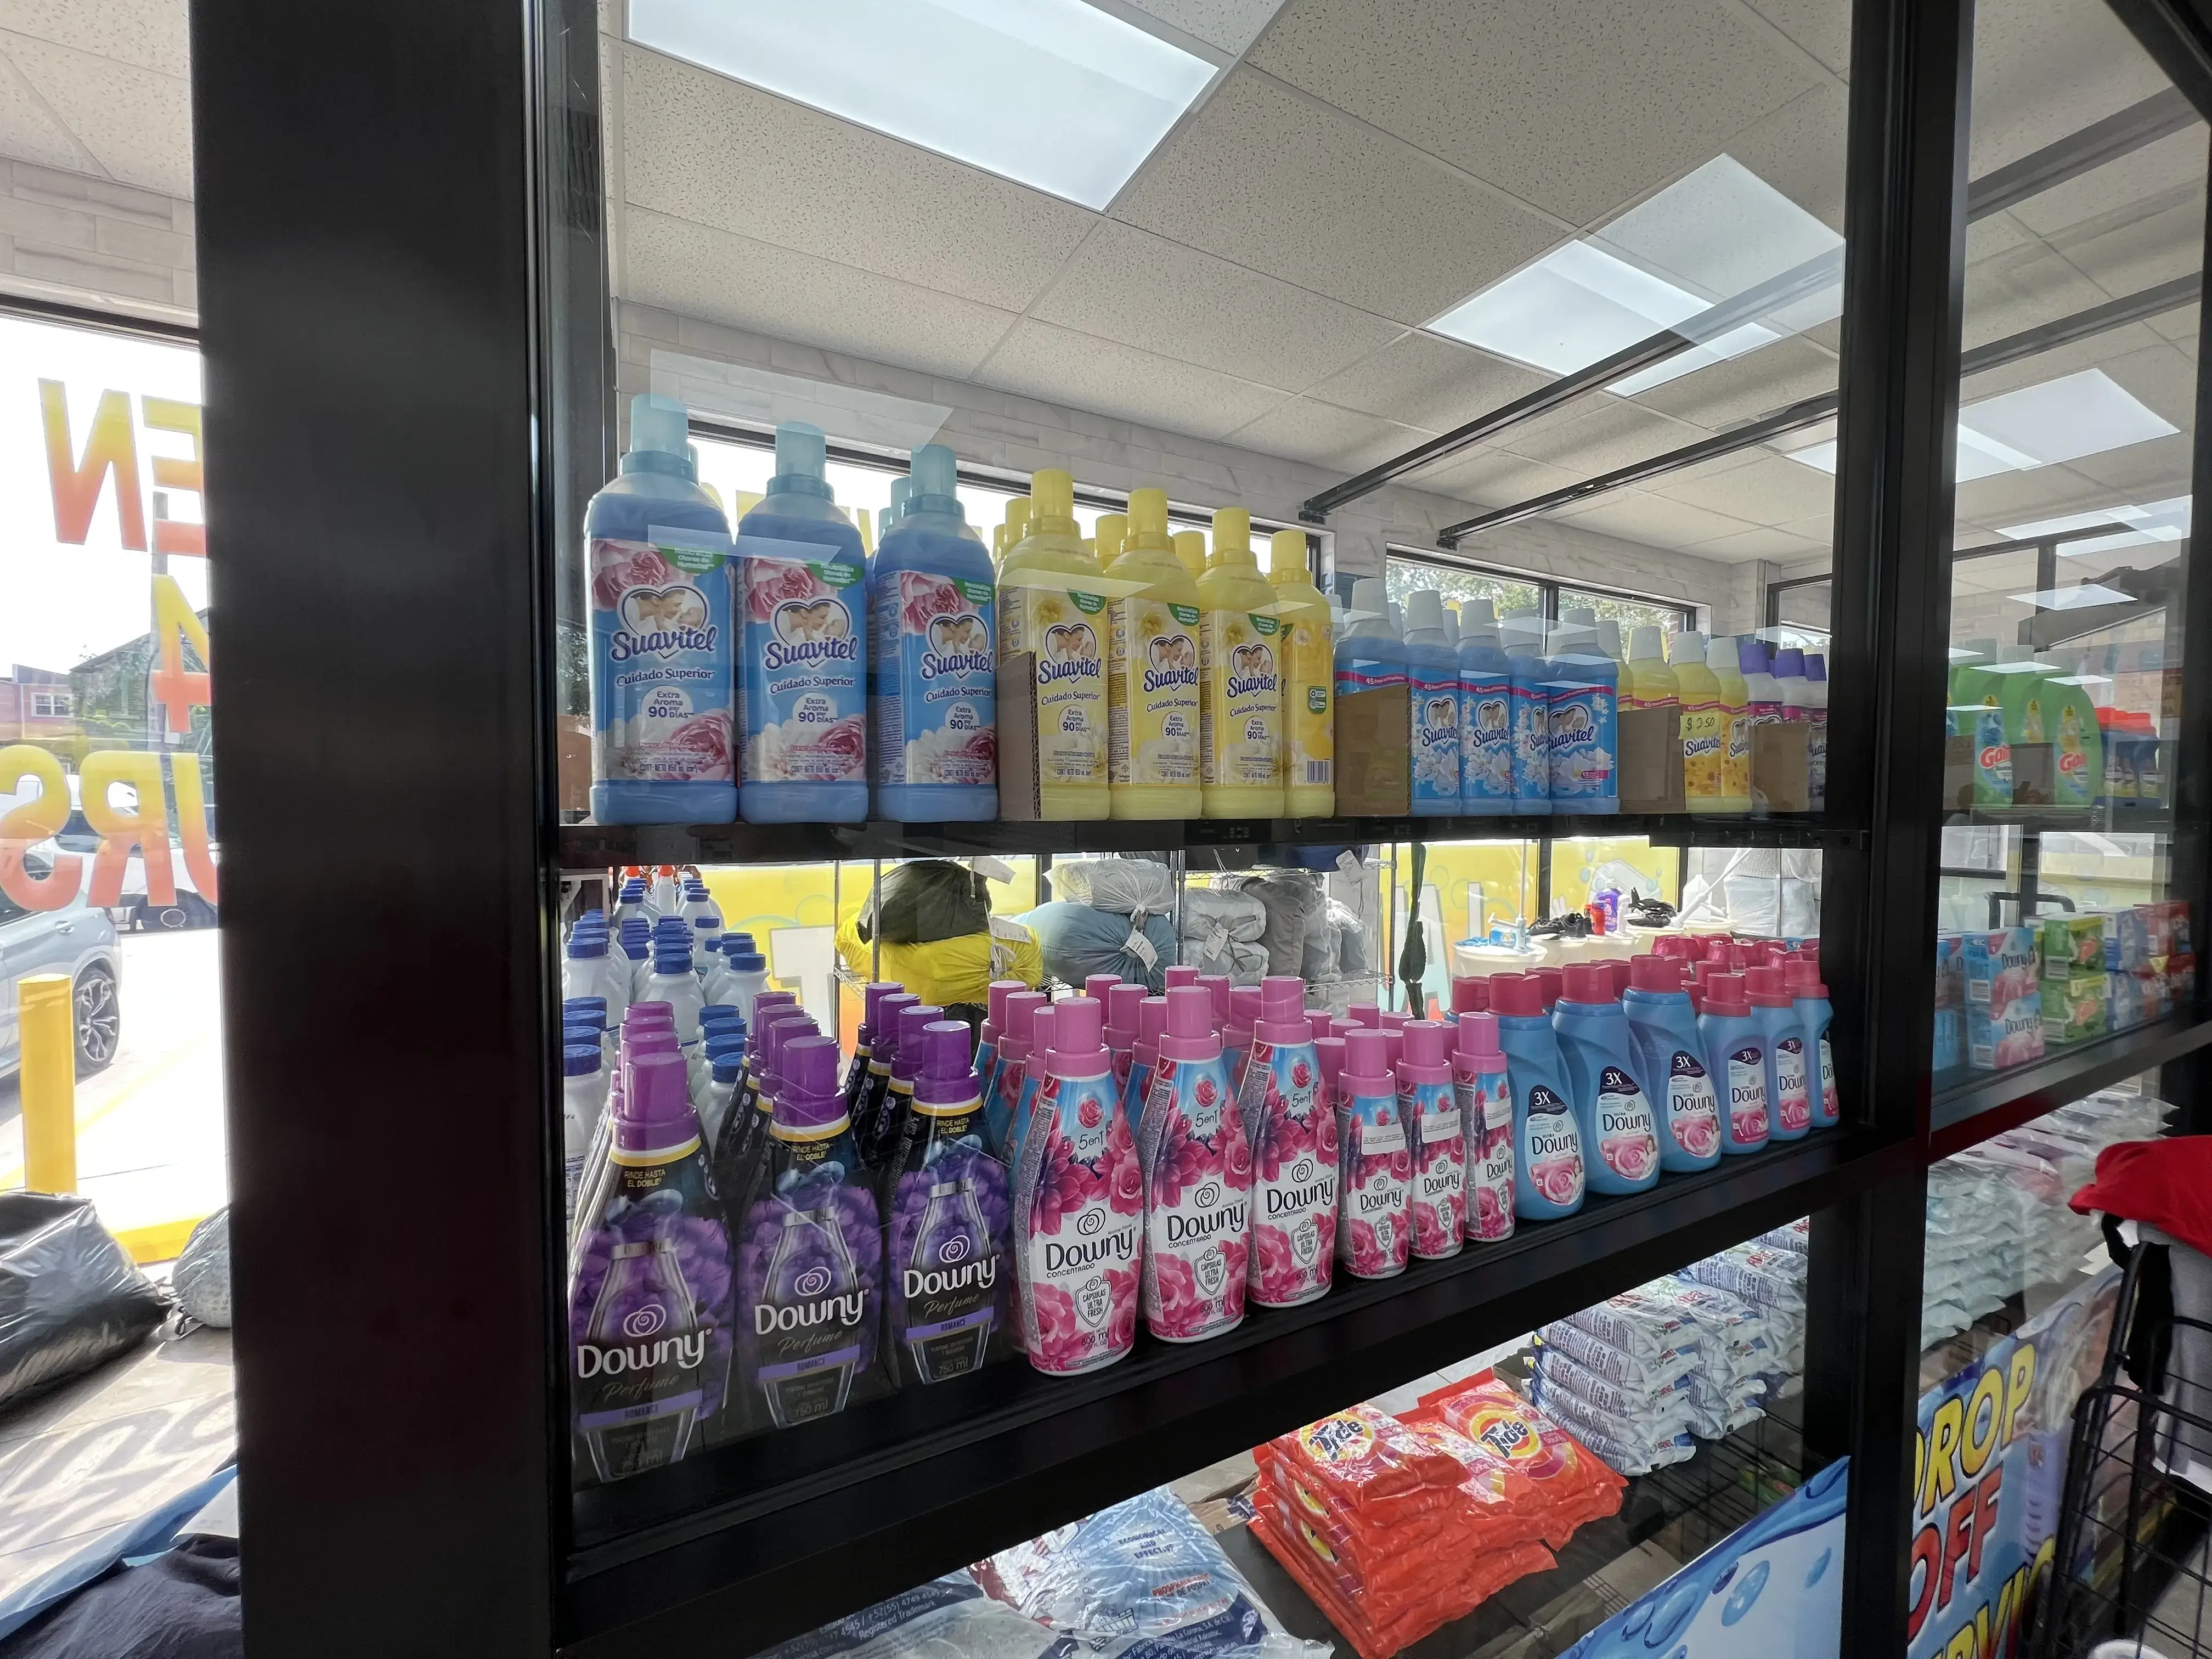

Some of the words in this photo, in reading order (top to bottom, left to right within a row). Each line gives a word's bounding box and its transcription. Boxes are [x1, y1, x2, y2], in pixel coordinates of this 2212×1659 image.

[611, 626, 718, 661] Suavitel
[766, 637, 857, 669] Suavitel
[922, 650, 993, 679] Suavitel
[1038, 658, 1102, 684] Suavitel
[617, 670, 663, 687] Cuidado
[665, 668, 713, 679] Superior
[770, 678, 811, 693] Cuidado
[813, 676, 855, 687] Superior
[1144, 667, 1199, 692] Suavitel
[1365, 677, 1374, 685] 45
[926, 687, 960, 702] Cuidado
[961, 686, 992, 697] Superior
[1227, 674, 1277, 698] Suavitel
[1041, 691, 1072, 706] Cuidado
[1073, 691, 1101, 701] Superior
[1147, 699, 1173, 712] Cuidado
[1173, 698, 1198, 707] Superior
[648, 706, 668, 718] 90
[798, 712, 815, 723] 90
[1230, 706, 1254, 717] Cuidado
[1255, 704, 1277, 712] Superior
[950, 720, 963, 730] 90
[1063, 722, 1075, 731] 90
[1165, 727, 1176, 736] 90
[1787, 1040, 1796, 1051] 3X
[1675, 1055, 1691, 1069] 3X
[1741, 1051, 1753, 1062] 3X
[1605, 1072, 1623, 1085] 3X
[1534, 1090, 1551, 1105] 3X
[1731, 1086, 1766, 1103] Downy
[1673, 1094, 1716, 1112] Downy
[954, 1117, 970, 1125] HASTA
[1602, 1113, 1651, 1132] Downy
[812, 1143, 830, 1152] HASTA
[1532, 1131, 1578, 1155] Downy
[624, 1171, 644, 1179] RINDE
[645, 1169, 666, 1178] HASTA
[1487, 1158, 1514, 1178] Downy
[1424, 1172, 1460, 1194] Downy
[1267, 1178, 1333, 1214] Downy
[1360, 1189, 1402, 1210] Downy
[1268, 1207, 1306, 1220] CONCENTRADO
[1167, 1203, 1244, 1242] Downy
[1168, 1234, 1211, 1249] CONCENTRADO
[1297, 1229, 1316, 1242] CÁPSULAS
[1046, 1228, 1133, 1271] Downy
[1300, 1239, 1313, 1249] ULTRA
[1301, 1247, 1313, 1256] FRESH
[1046, 1262, 1096, 1278] CONCENTRADO
[1200, 1259, 1222, 1271] CÁPSULAS
[1205, 1268, 1219, 1278] ULTRA
[904, 1255, 996, 1298] Downy
[1205, 1277, 1219, 1286] FRESH
[1082, 1288, 1107, 1302] CÁPSULAS
[924, 1294, 980, 1319] Perfume
[1087, 1298, 1103, 1310] ULTRA
[754, 1290, 864, 1335] Downy
[1087, 1307, 1103, 1318] FRESH
[940, 1318, 966, 1332] ROMANCE
[778, 1330, 843, 1358] Perfume
[1081, 1335, 1096, 1346] 800
[577, 1330, 706, 1378] Downy
[797, 1357, 826, 1372] ROMANCE
[939, 1363, 953, 1375] 750
[956, 1357, 968, 1370] ml
[602, 1374, 680, 1403] Perfume
[624, 1403, 659, 1420] ROMANCE
[795, 1404, 812, 1419] 750
[814, 1398, 829, 1414] ml
[1308, 1418, 1364, 1463] Tide
[1480, 1418, 1530, 1459] Tide
[867, 1601, 900, 1621] +52(55)
[901, 1594, 920, 1606] 4749
[859, 1615, 898, 1641] Registered
[898, 1599, 937, 1620] Trademark
